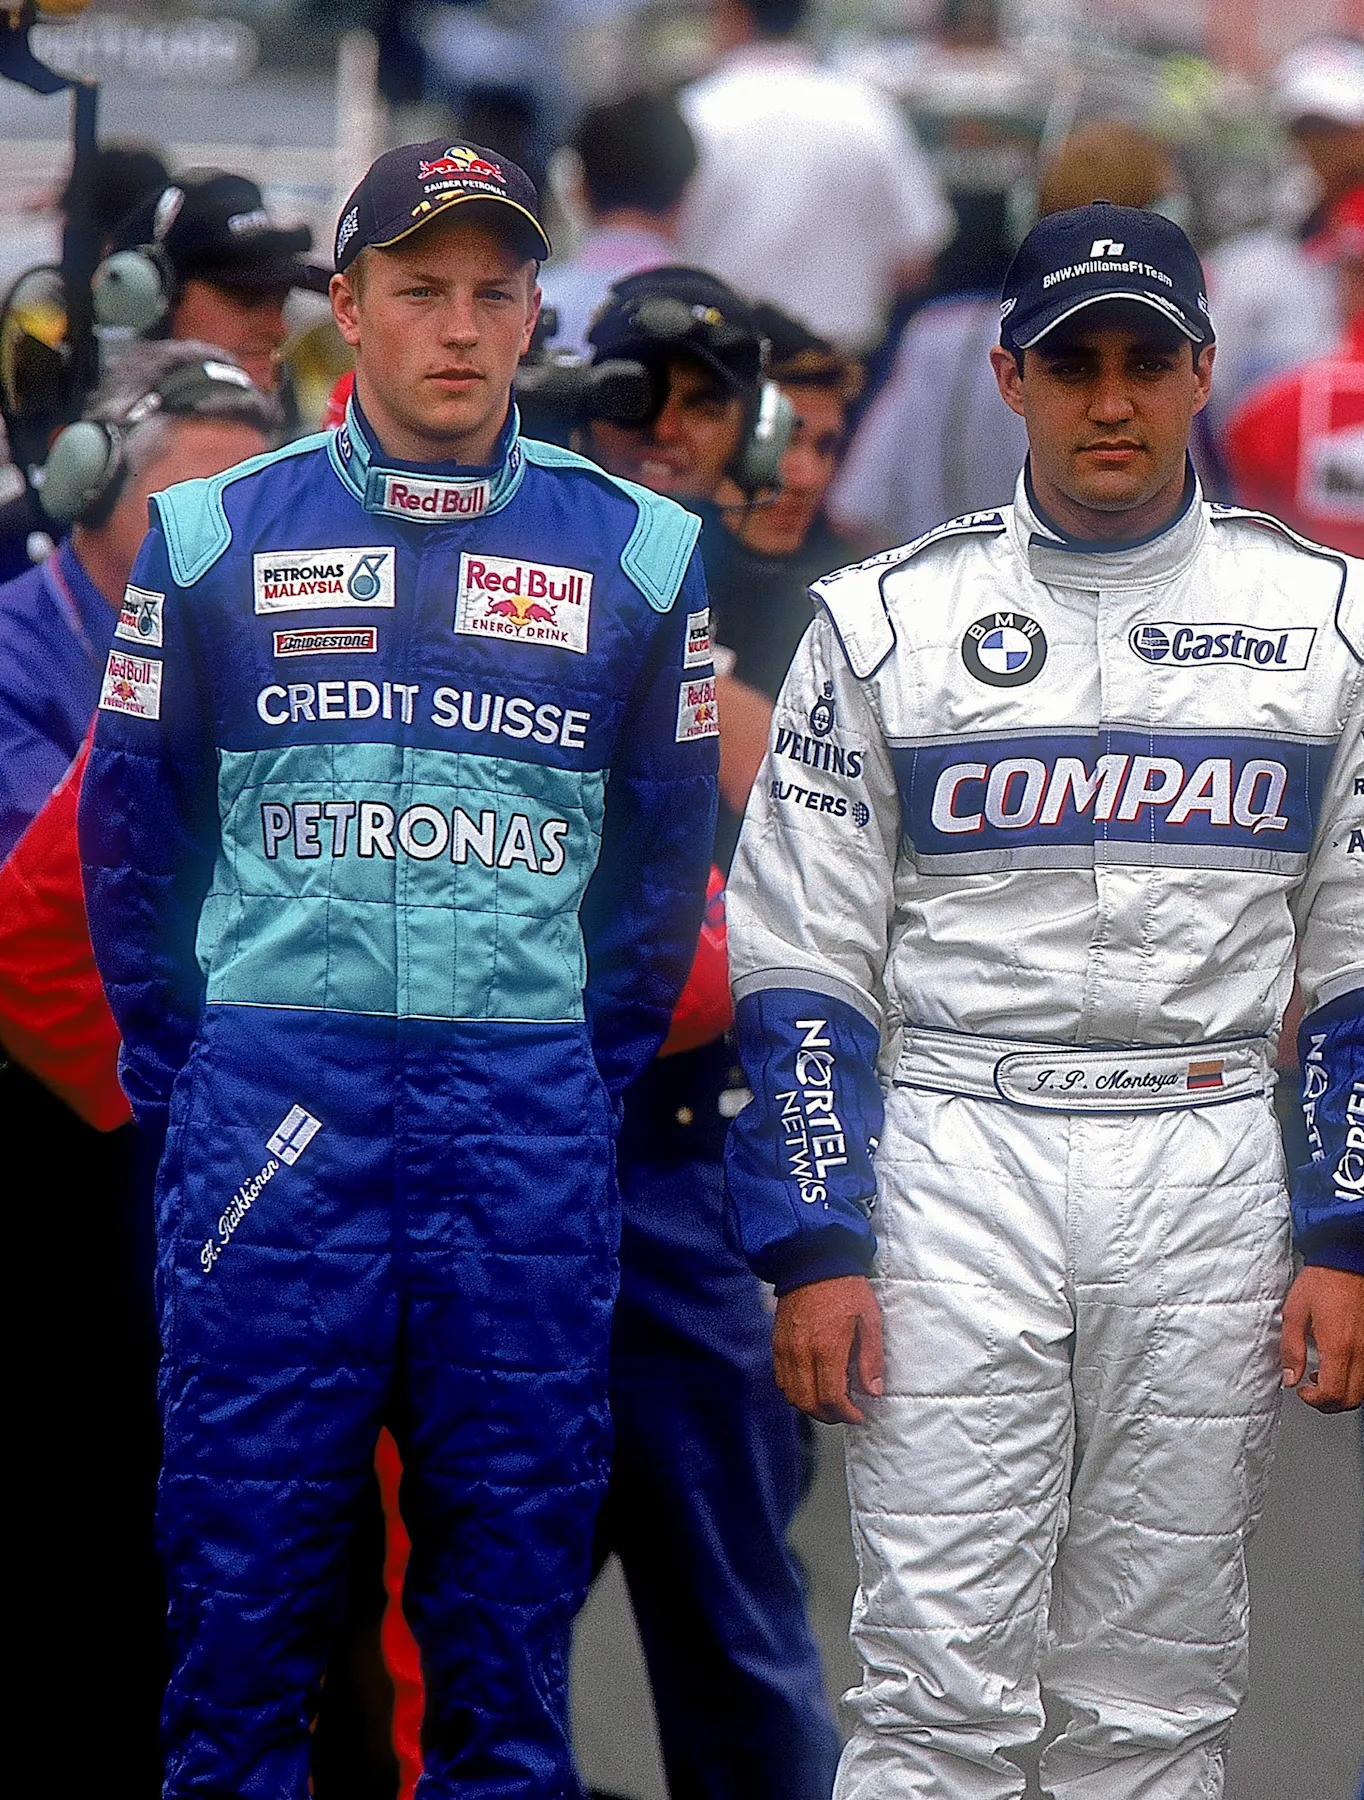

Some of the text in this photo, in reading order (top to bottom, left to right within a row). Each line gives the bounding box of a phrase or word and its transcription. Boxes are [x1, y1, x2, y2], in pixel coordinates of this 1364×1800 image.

[424, 180, 462, 193] SAUBER
[390, 483, 485, 513] Red Bull
[263, 564, 344, 583] PETRONAS
[263, 580, 344, 600] MALAYSIA
[466, 560, 584, 605] Red Bull
[280, 635, 370, 650] BRIDGESTONE
[471, 618, 570, 643] ENERGY DRINK
[968, 612, 1041, 641] BMW
[1171, 627, 1291, 665] Castrol
[256, 680, 591, 749] CREDIT SUISSE
[773, 726, 863, 780] VELTINS
[930, 753, 1290, 835] COMPAQ
[261, 801, 569, 875] PETRONAS
[1095, 1069, 1179, 1093] Montoya
[795, 1019, 848, 1180] NORTEL
[218, 1158, 281, 1245] Räikkönen
